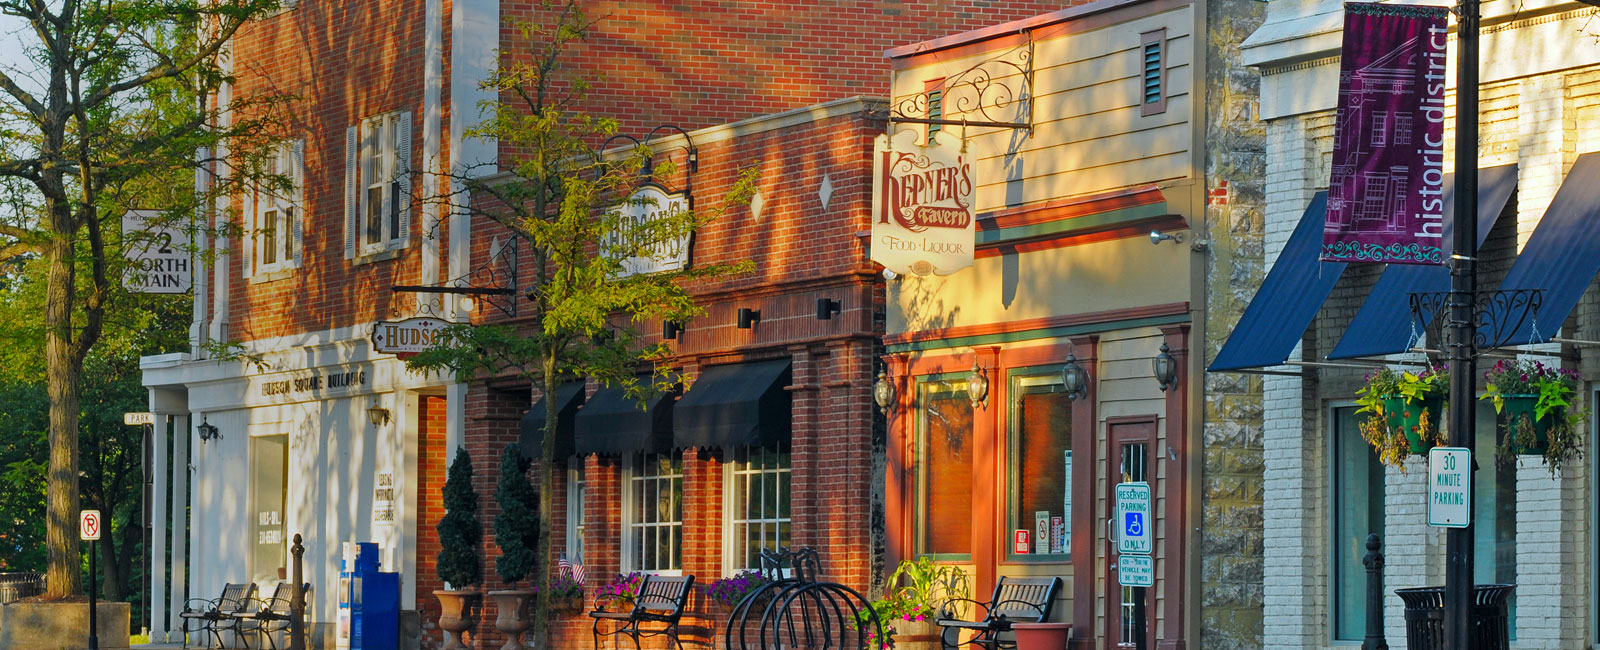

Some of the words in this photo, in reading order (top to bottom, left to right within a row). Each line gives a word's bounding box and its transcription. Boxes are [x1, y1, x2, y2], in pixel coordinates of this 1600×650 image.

[1419, 23, 1449, 123] district
[878, 151, 972, 230] KEPNER'S
[1414, 133, 1444, 238] historic
[918, 208, 967, 226] Tavern
[923, 238, 967, 254] LIQUOR
[128, 258, 187, 272] ORTH
[133, 274, 180, 288] MAIN
[385, 325, 466, 349] HUDSO
[131, 414, 152, 423] PARK
[1443, 455, 1456, 471] 30
[1437, 473, 1461, 486] MINUTE
[1118, 491, 1148, 500] RESERVED
[1434, 491, 1464, 505] PARKING
[1120, 503, 1147, 511] PARKING
[1124, 540, 1146, 549] ONLY
